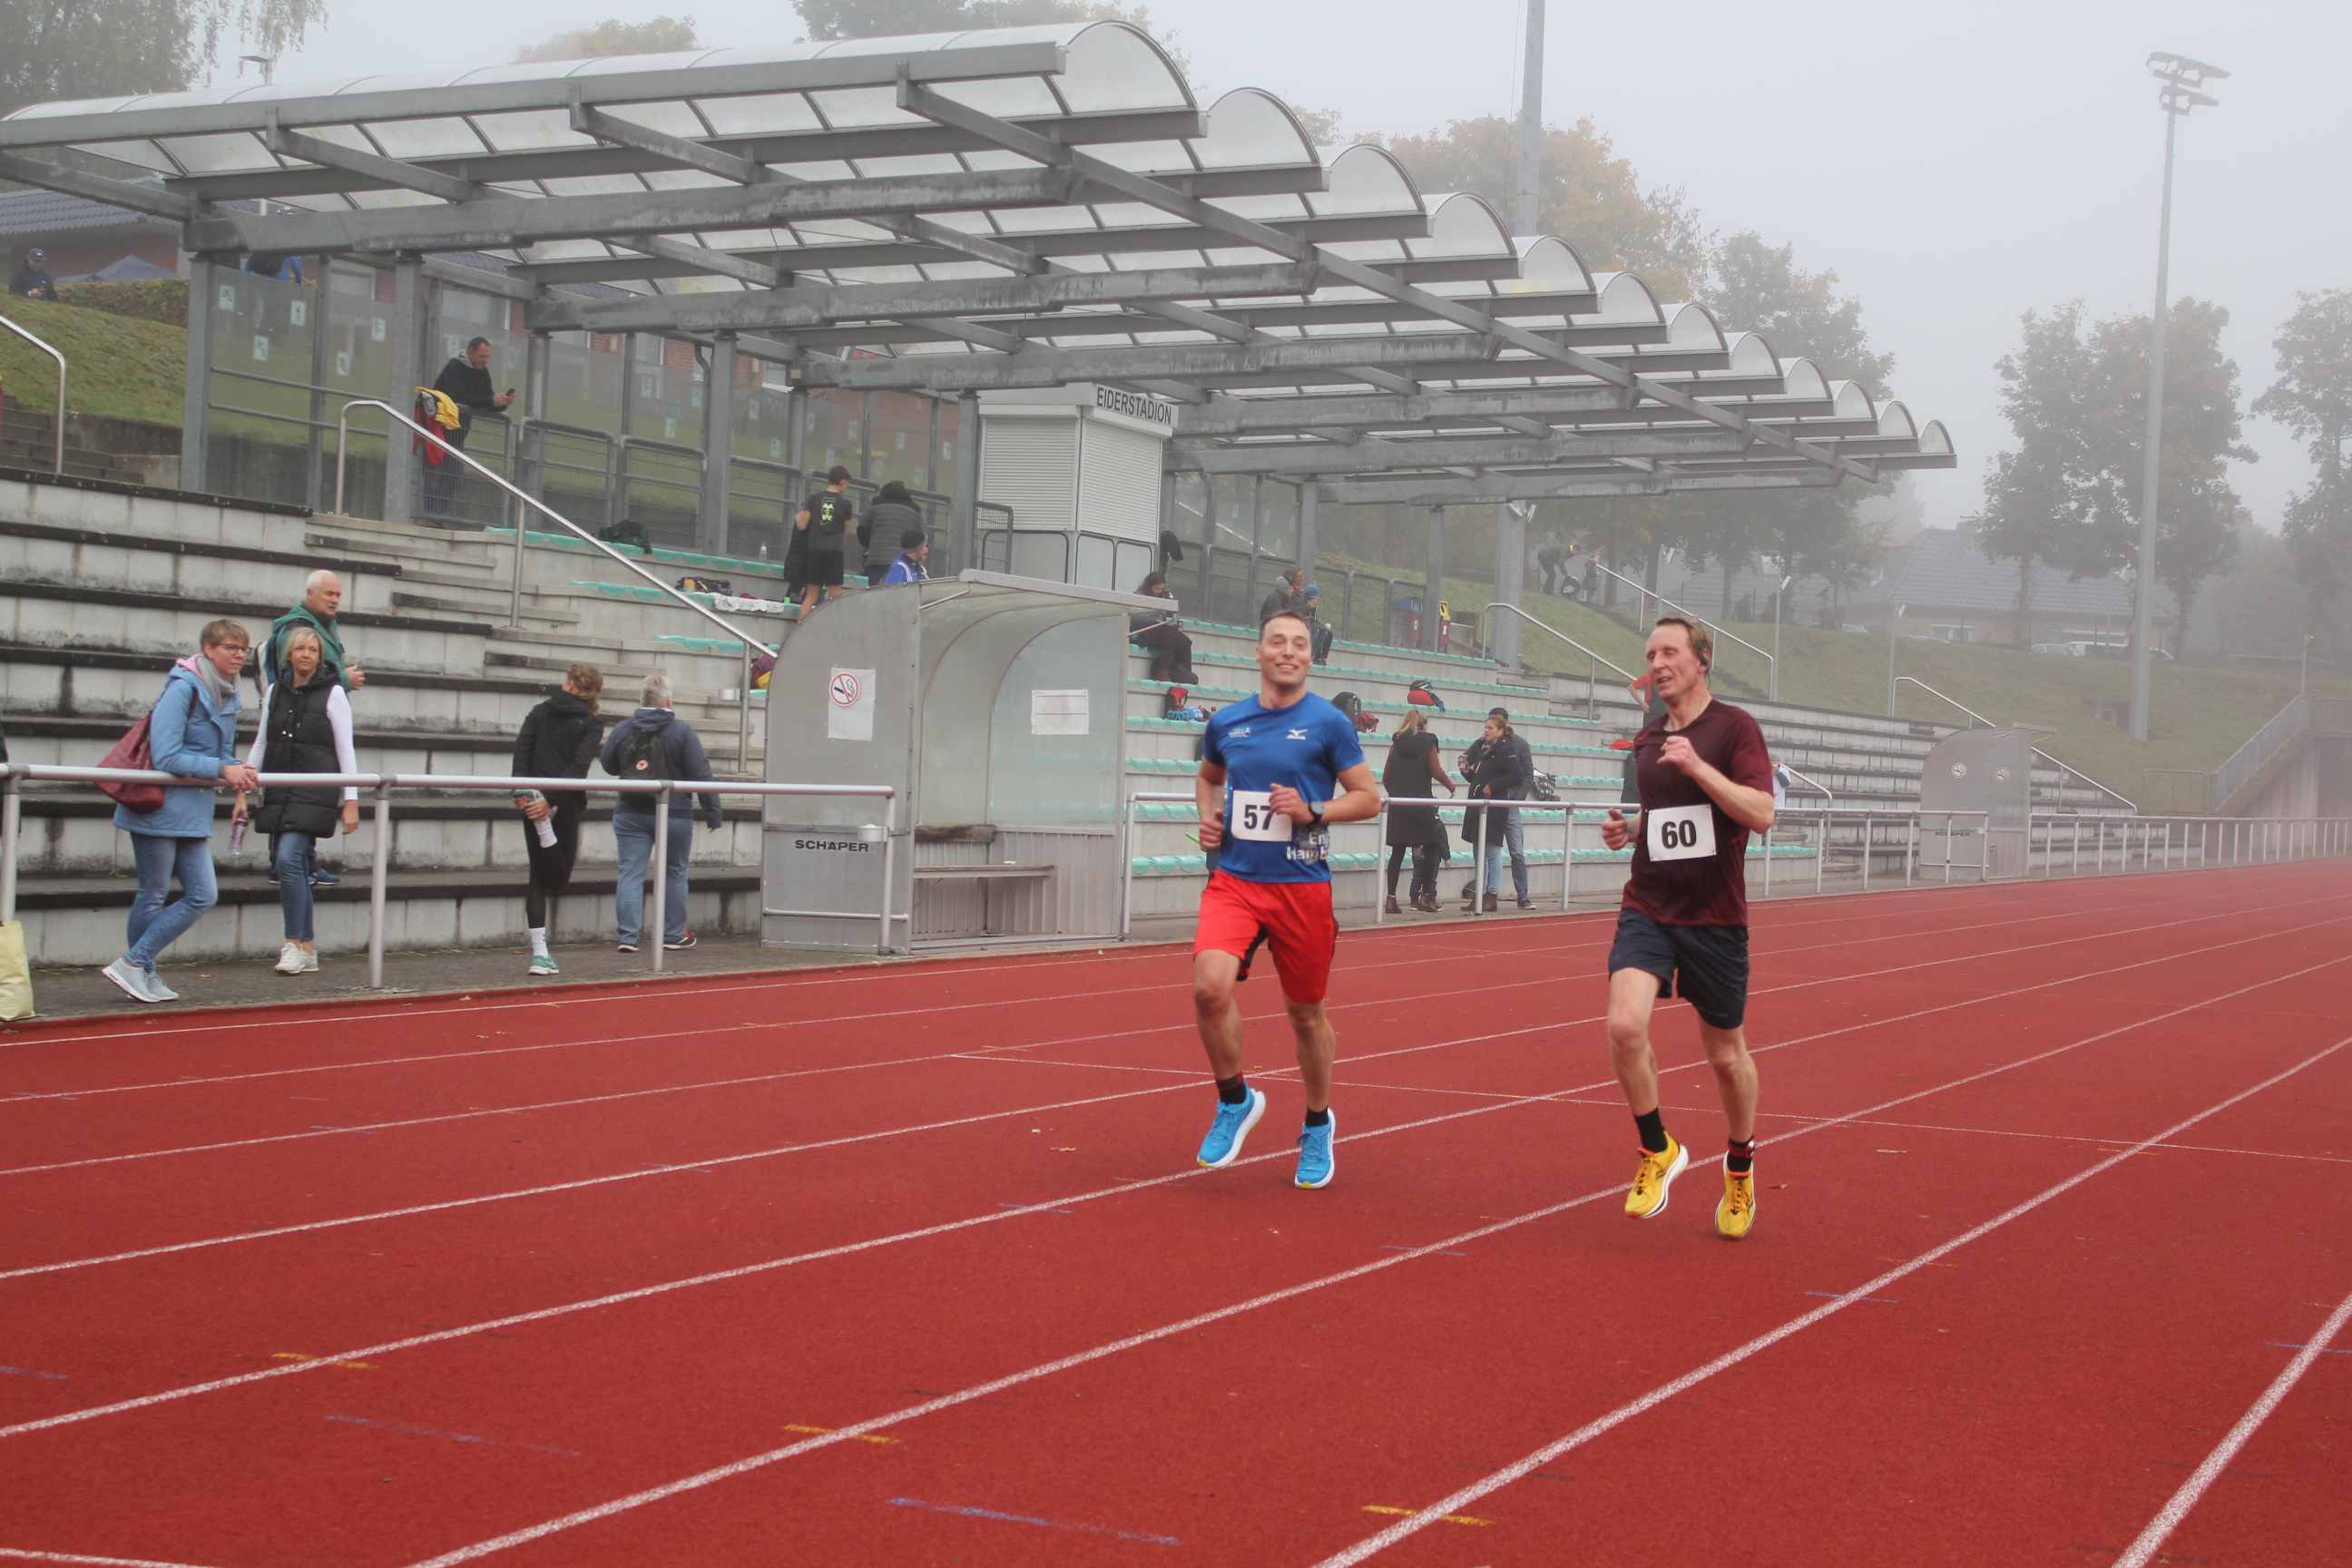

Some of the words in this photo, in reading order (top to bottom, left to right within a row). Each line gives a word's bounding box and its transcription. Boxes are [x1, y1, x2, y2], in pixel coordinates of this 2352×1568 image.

[1096, 386, 1172, 426] EIDERSTADION
[1243, 804, 1275, 830] 57
[1661, 819, 1697, 849] 60
